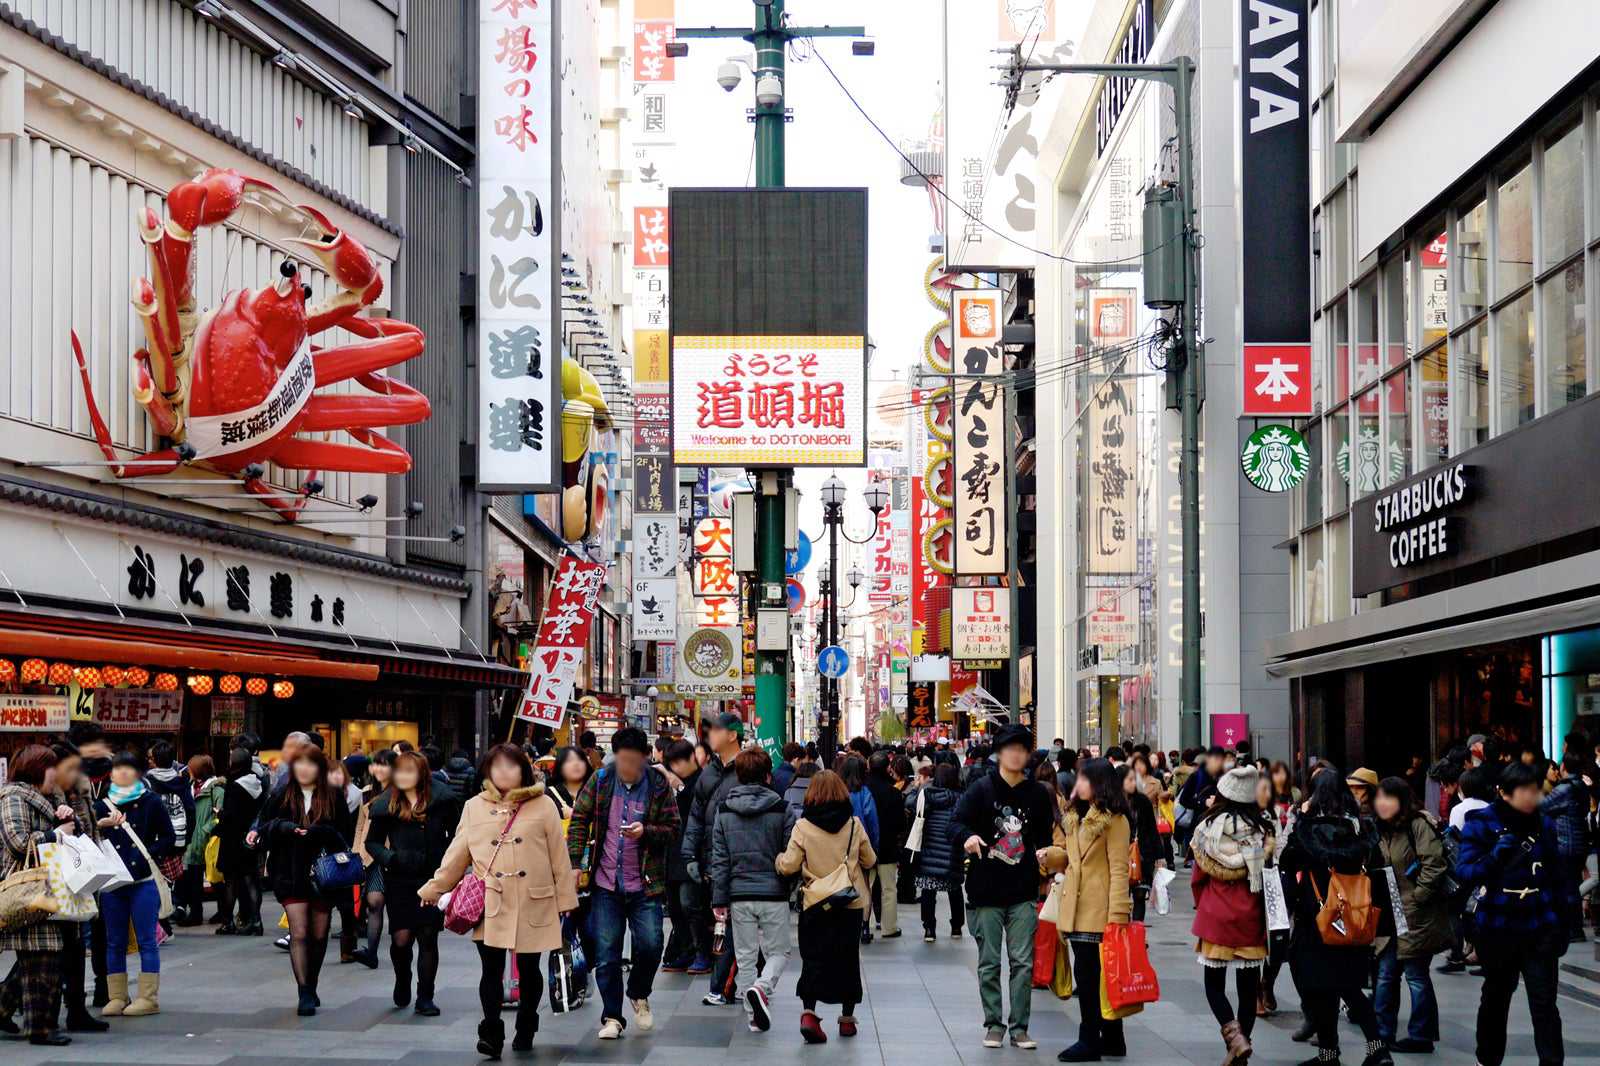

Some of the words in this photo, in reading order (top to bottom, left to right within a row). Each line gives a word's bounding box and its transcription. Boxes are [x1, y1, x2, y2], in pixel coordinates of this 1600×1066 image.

[963, 158, 983, 244] 道頓堀店
[486, 185, 544, 452] かに道楽
[723, 353, 819, 377] ようこそ
[1254, 358, 1299, 402] 本
[697, 380, 846, 429] 道頓堀
[691, 434, 747, 445] Welcome
[750, 434, 767, 445] to
[769, 434, 852, 445] DOTONBORI
[637, 458, 648, 466] 2F
[1374, 463, 1466, 532] STARBUCKS
[1389, 517, 1448, 568] COFFEE
[127, 545, 293, 619] かに道楽
[636, 582, 648, 592] 6F
[677, 684, 706, 693] CAFE
[97, 699, 180, 722] お土産コーナー
[528, 704, 558, 722] 入荷
